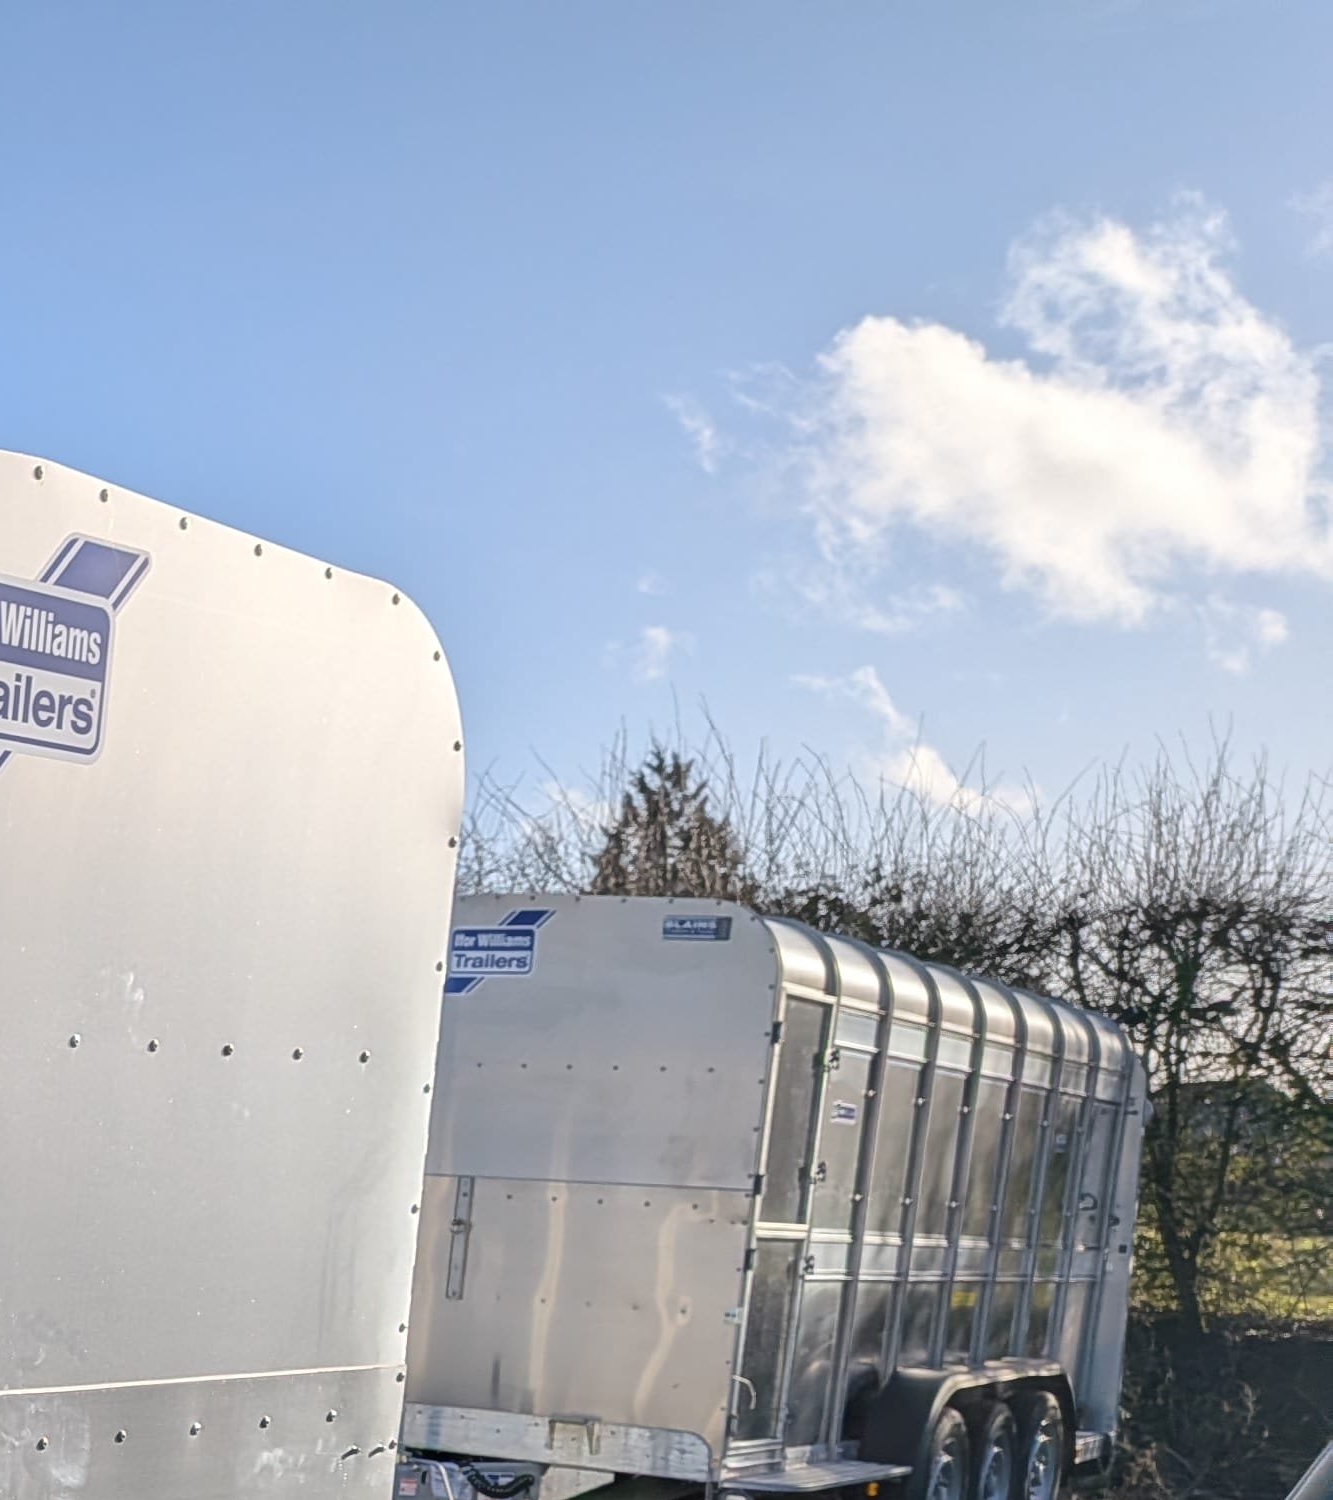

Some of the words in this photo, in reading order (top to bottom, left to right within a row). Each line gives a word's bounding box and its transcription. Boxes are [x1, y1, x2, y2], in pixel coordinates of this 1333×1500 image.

[0, 600, 101, 665] Williams
[454, 933, 476, 947] Ifor
[477, 933, 532, 948] Williams
[454, 954, 528, 969] Trailers
